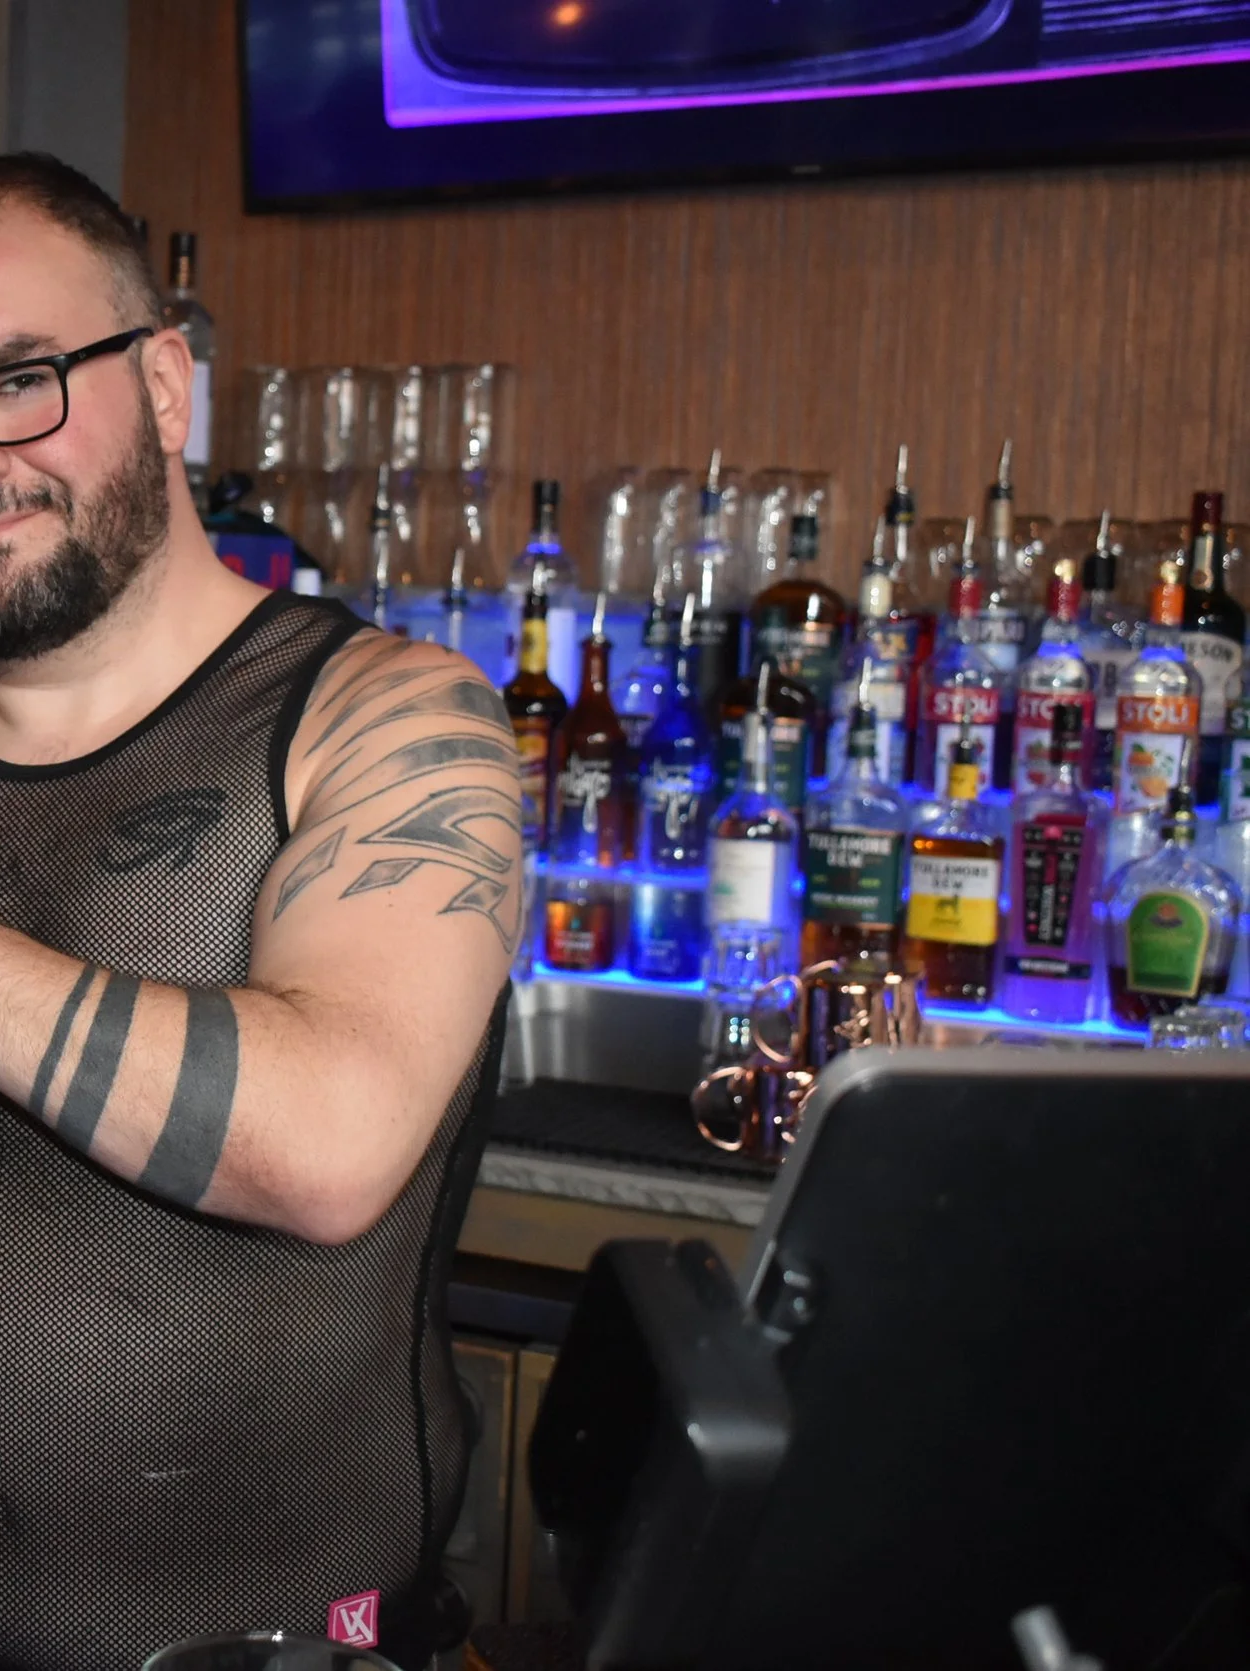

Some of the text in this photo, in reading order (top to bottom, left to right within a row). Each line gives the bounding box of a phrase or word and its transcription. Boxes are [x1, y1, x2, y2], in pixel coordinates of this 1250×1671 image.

[1123, 701, 1190, 724] STOLI
[808, 834, 892, 856] TULLAMORE
[914, 861, 989, 878] TULLAMORE
